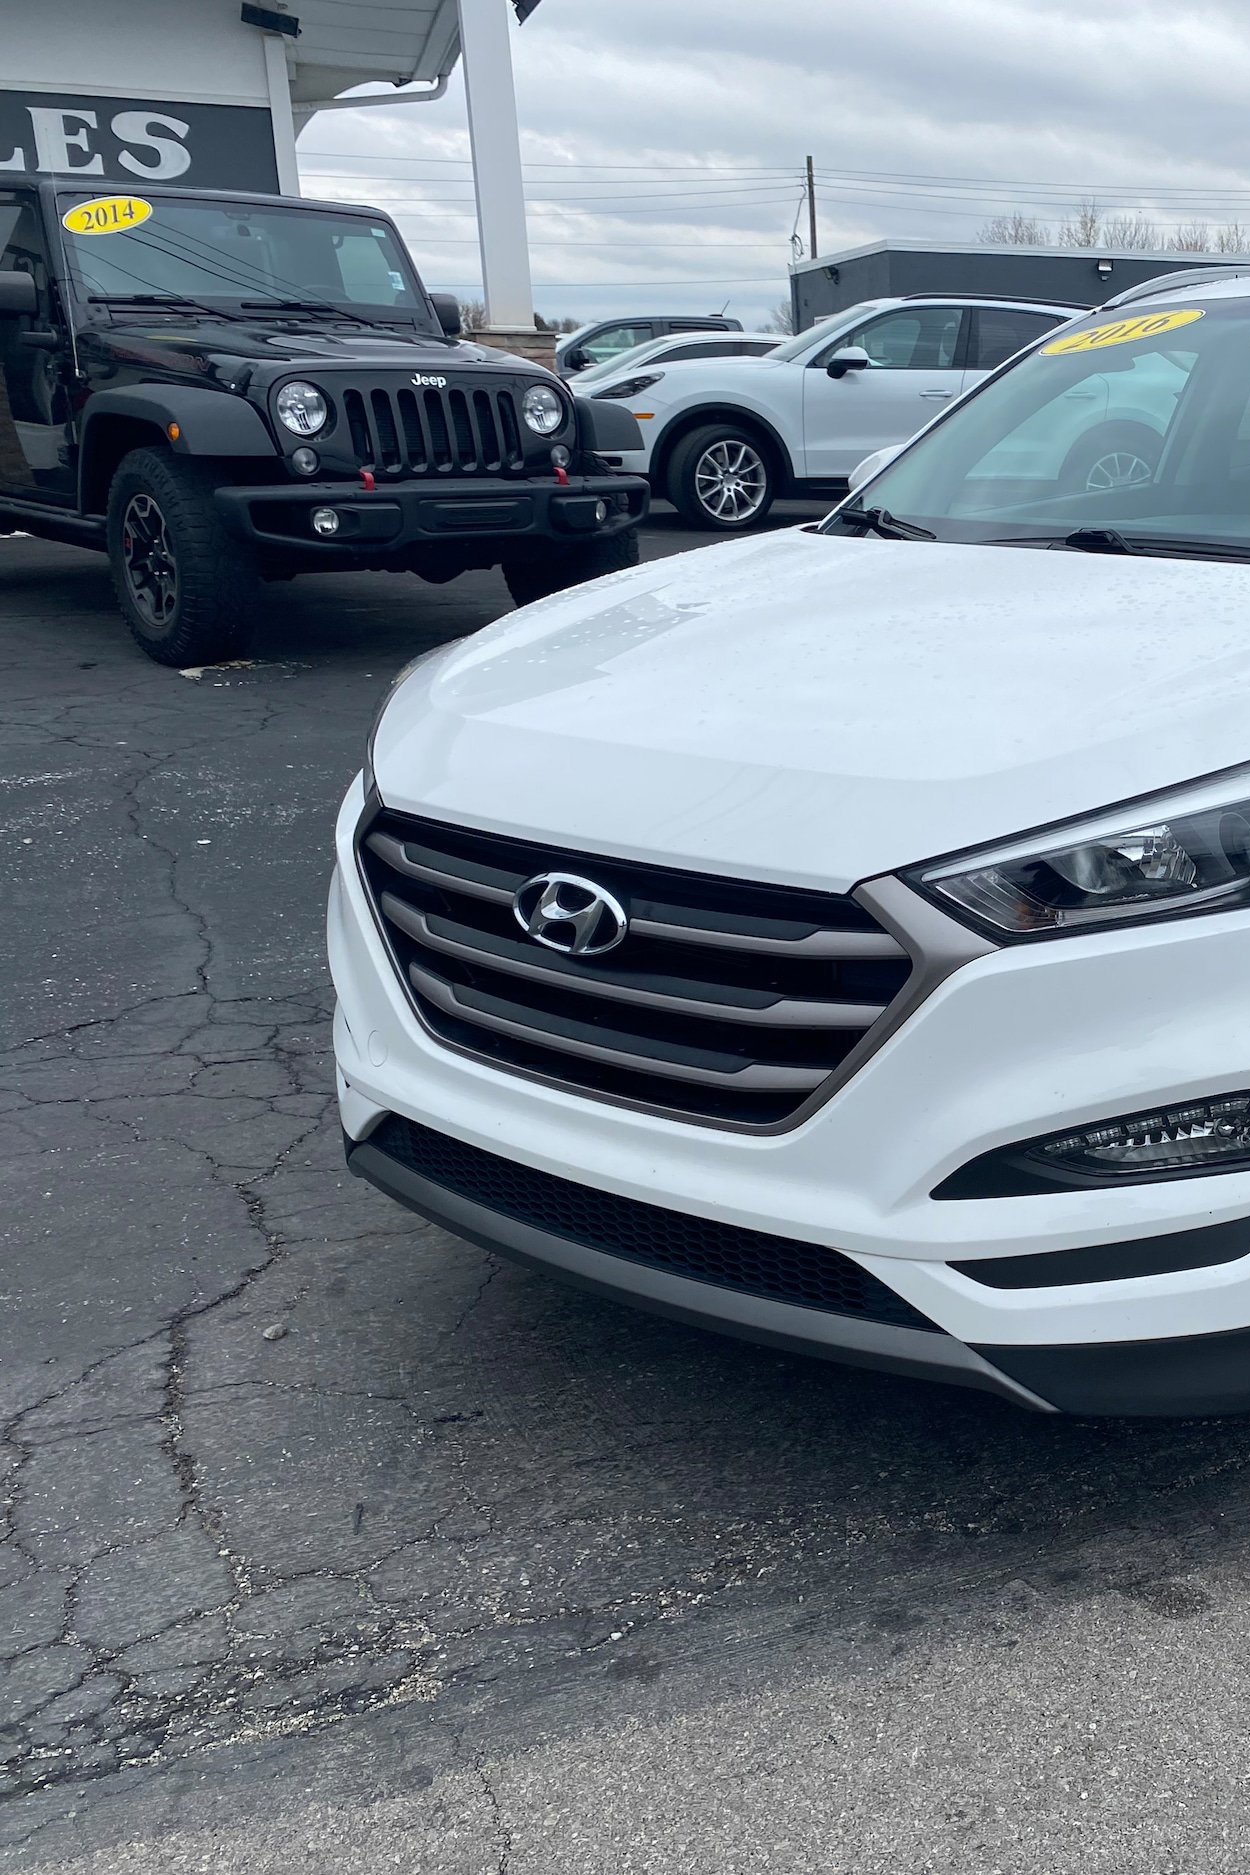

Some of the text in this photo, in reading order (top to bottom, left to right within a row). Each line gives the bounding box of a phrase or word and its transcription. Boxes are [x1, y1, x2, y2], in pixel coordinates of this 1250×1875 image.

[80, 200, 135, 231] 2014
[1059, 311, 1184, 351] 2016
[411, 373, 447, 388] Jeep
